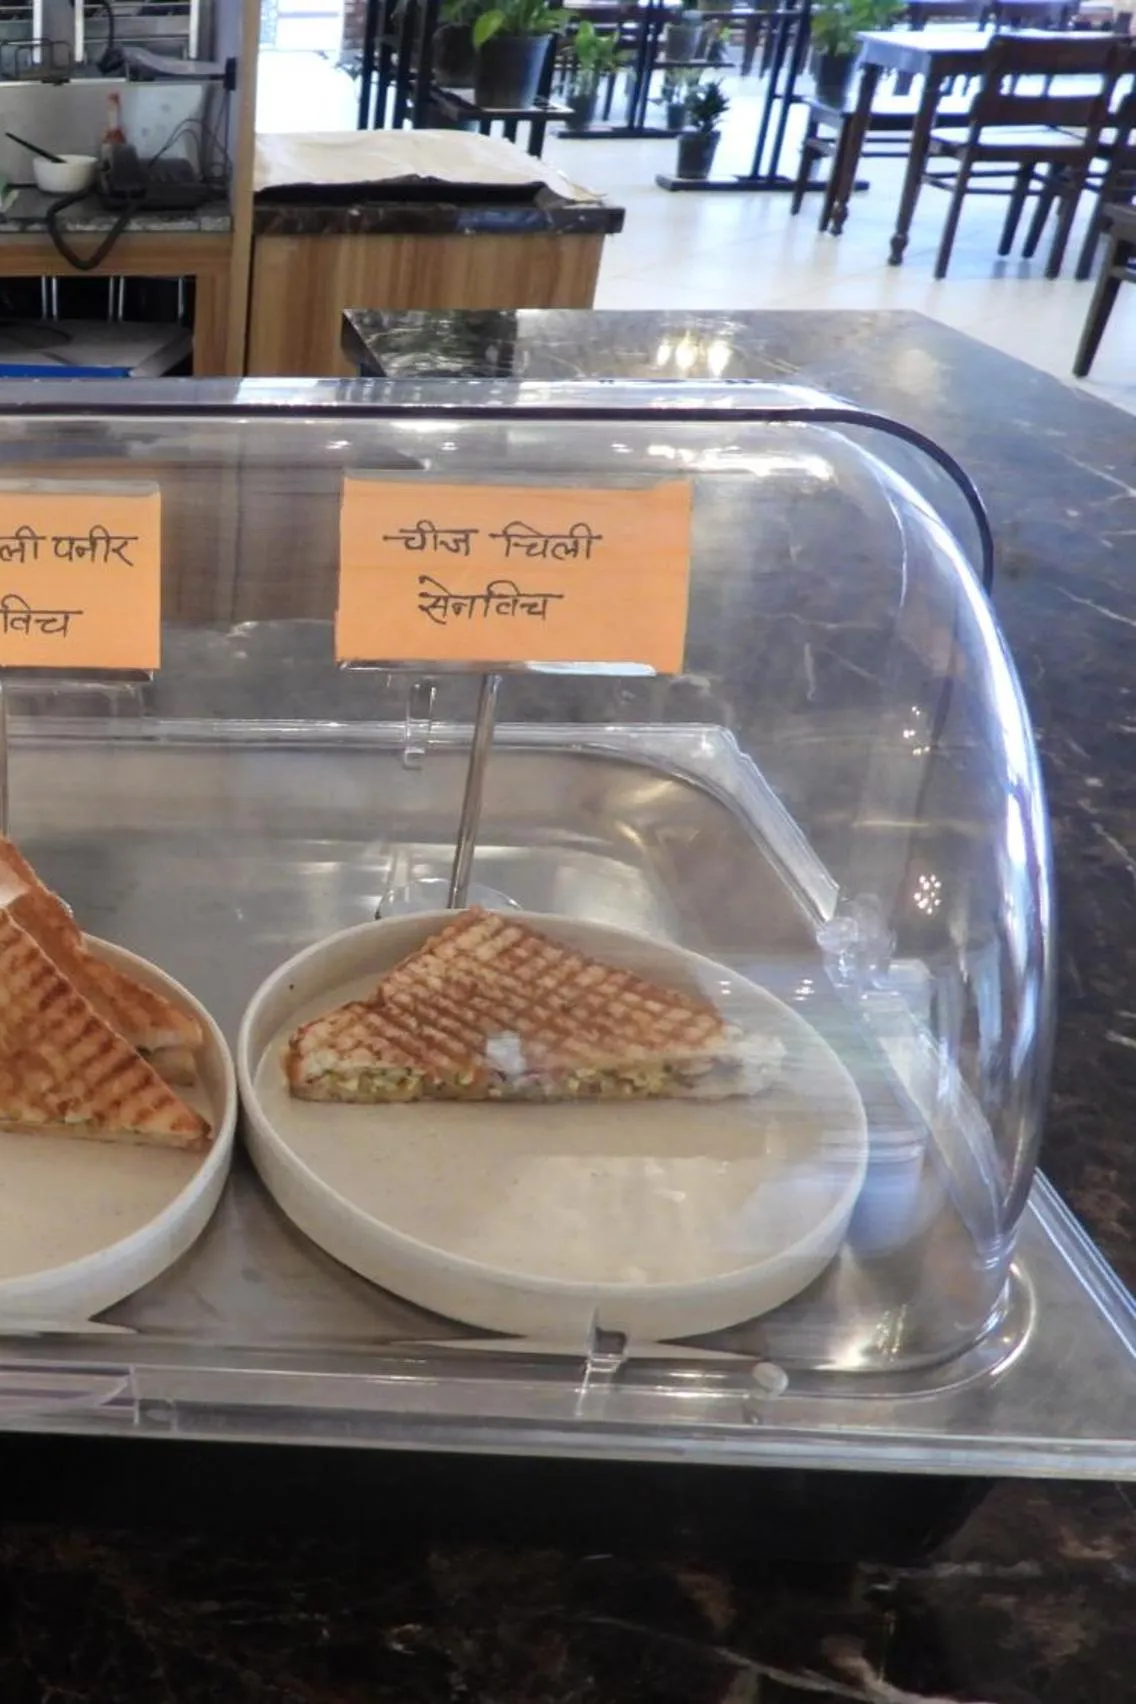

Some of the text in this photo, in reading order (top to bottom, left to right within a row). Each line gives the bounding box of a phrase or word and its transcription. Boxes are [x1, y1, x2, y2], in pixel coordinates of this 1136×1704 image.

[52, 525, 139, 567] पनीर
[382, 520, 603, 560] चीज चिली
